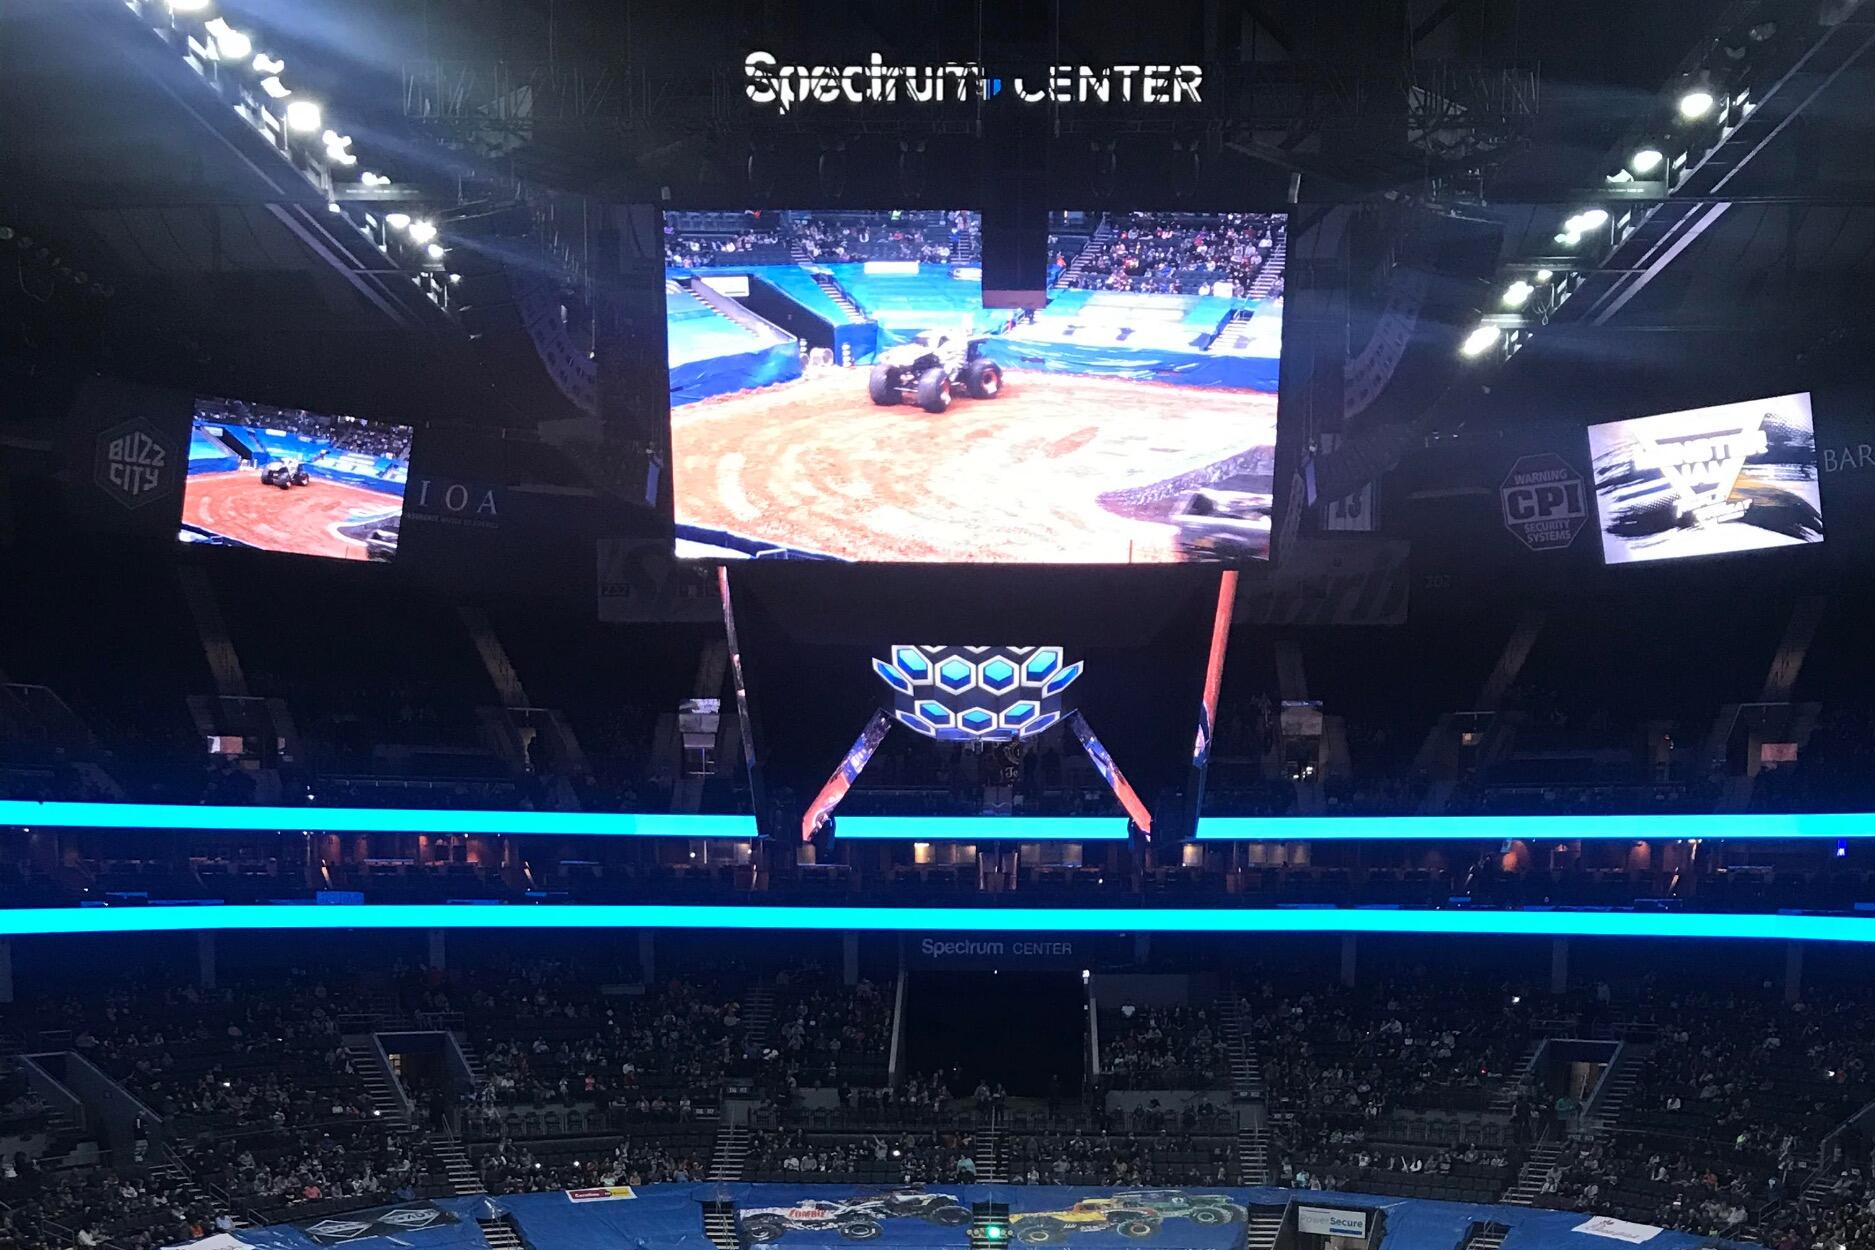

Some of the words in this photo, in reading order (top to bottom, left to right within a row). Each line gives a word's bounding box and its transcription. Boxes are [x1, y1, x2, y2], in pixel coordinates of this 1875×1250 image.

[745, 51, 984, 115] Spectrum
[1014, 65, 1203, 102] CENTER
[108, 431, 166, 467] BUZZ
[110, 462, 159, 496] CITY
[1514, 468, 1568, 485] WARNING
[1507, 484, 1581, 520] CPI
[1527, 530, 1571, 544] SYSTEMS
[921, 938, 1004, 958] Spectrum
[1013, 942, 1072, 955] CENTER
